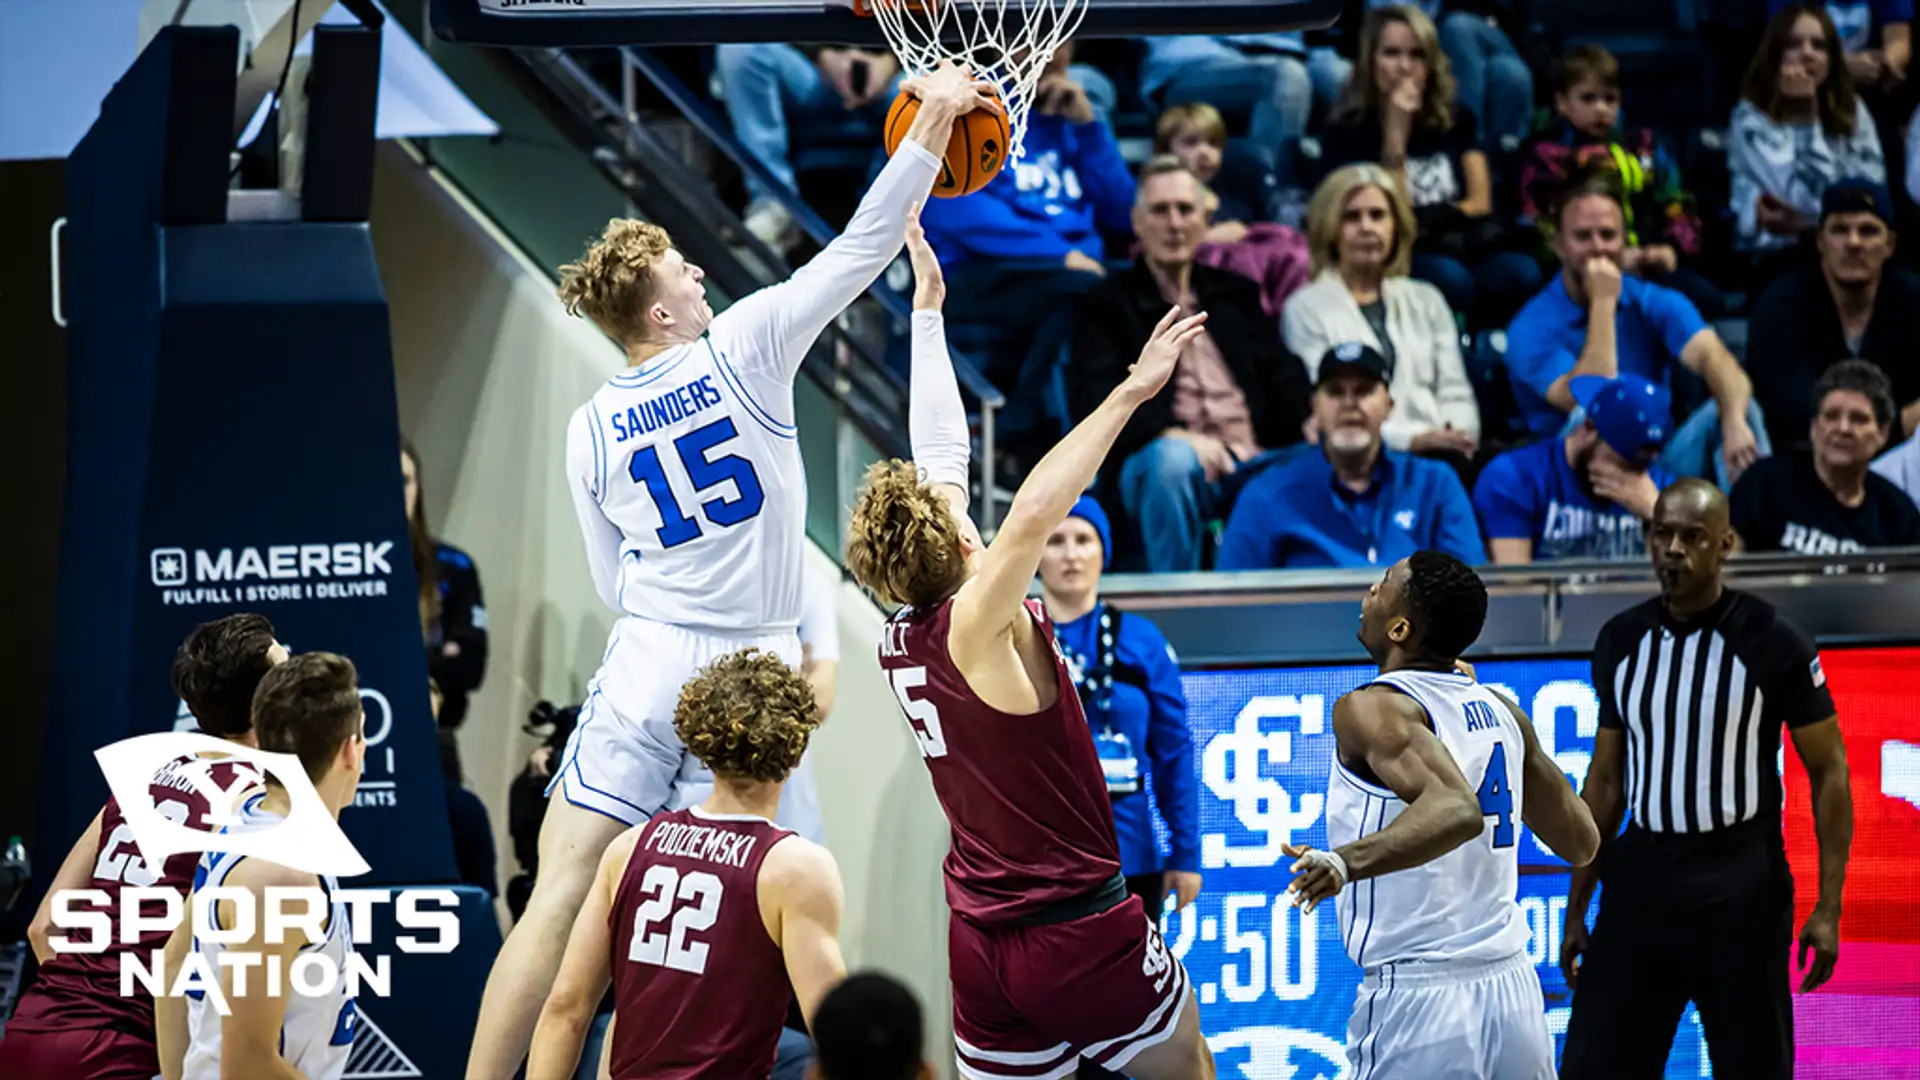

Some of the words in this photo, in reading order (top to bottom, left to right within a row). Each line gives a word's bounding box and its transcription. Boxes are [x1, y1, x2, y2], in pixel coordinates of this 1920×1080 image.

[611, 374, 722, 443] SAUNDERS
[628, 415, 765, 549] 15
[163, 587, 233, 605] FULFILL
[246, 584, 301, 602] STORE
[316, 580, 388, 599] DELIVER
[195, 541, 394, 582] MAERSK
[879, 622, 911, 657] OLT
[884, 666, 948, 759] 5
[1476, 741, 1515, 848] 4
[645, 821, 757, 868] PODZIEMSKI
[628, 864, 724, 974] 22
